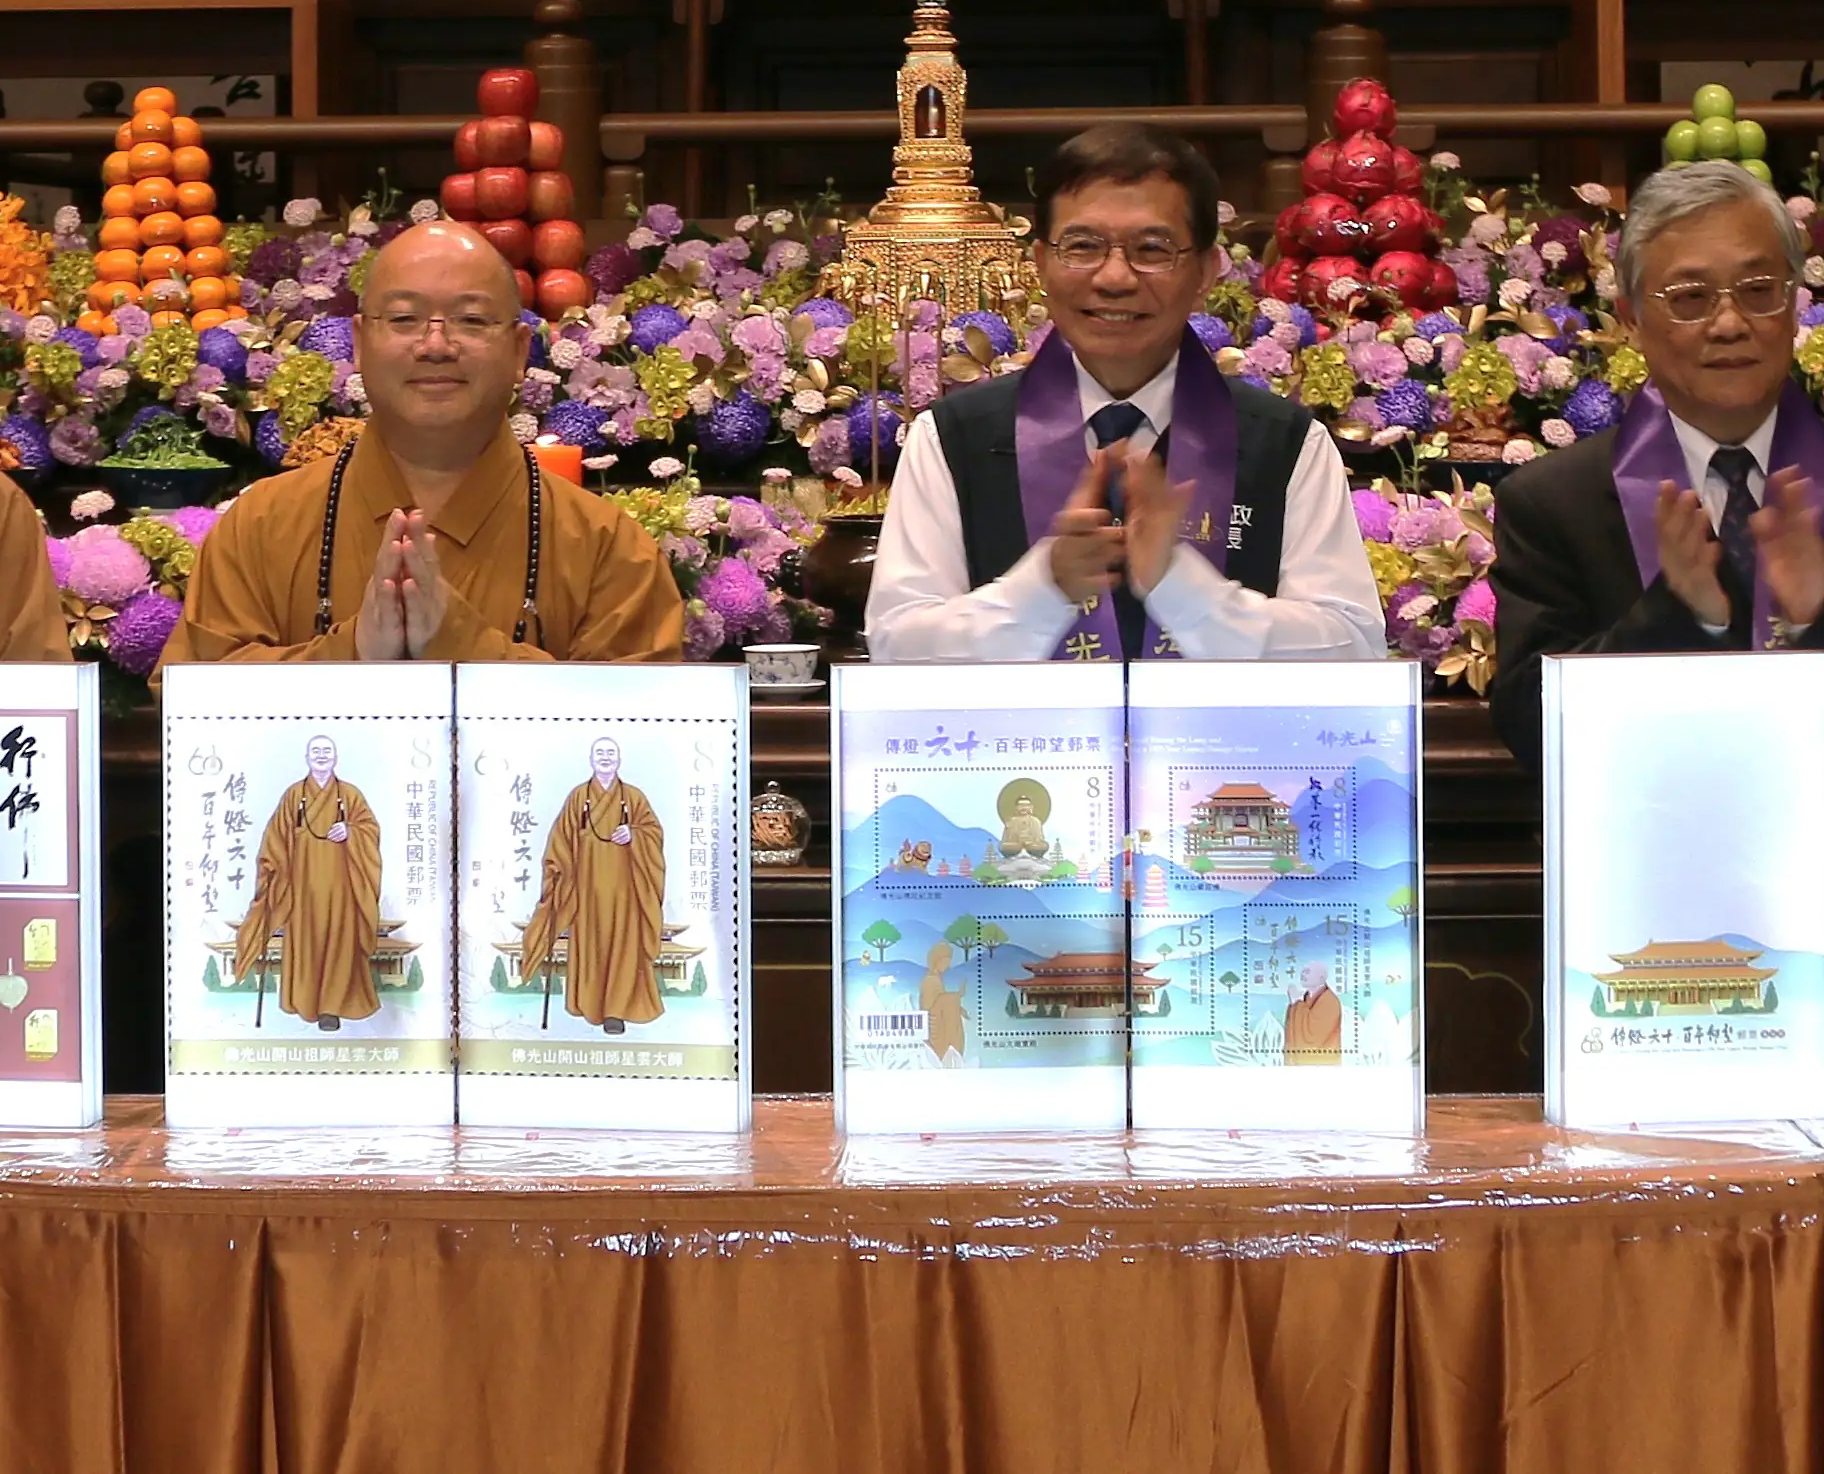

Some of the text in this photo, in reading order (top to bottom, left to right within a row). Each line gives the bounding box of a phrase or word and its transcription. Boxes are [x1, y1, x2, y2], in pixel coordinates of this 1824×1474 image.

[222, 772, 254, 891] 傳燈六十
[406, 780, 425, 906] 中華民國郵票
[510, 772, 539, 893] 傳燈六十
[1086, 776, 1101, 799] 8
[198, 791, 221, 914] 百年仰望
[688, 784, 709, 912] 中華民國郵票
[1177, 925, 1203, 948] 15
[1324, 913, 1349, 937] 15
